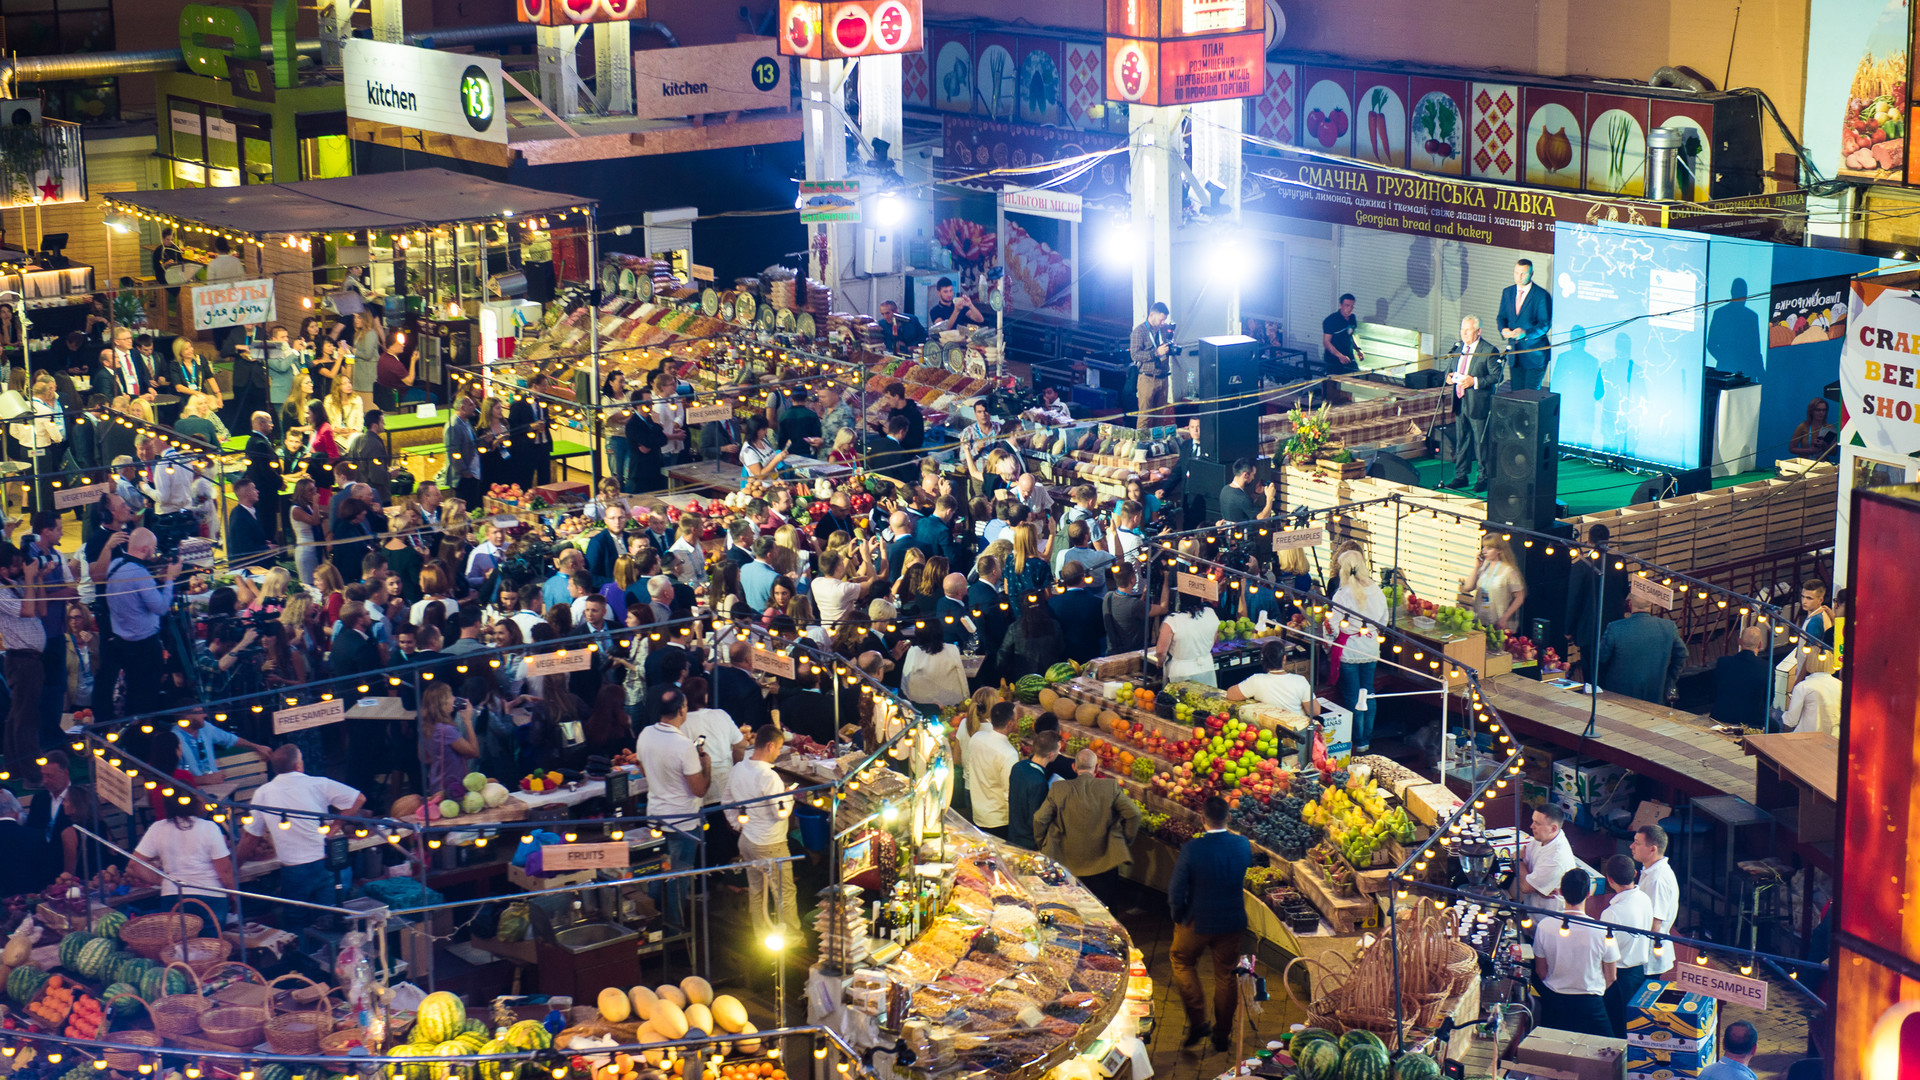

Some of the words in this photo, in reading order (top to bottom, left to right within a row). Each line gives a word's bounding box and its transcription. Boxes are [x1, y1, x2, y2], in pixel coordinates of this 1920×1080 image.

[1202, 43, 1224, 58] ПЛАН
[1189, 57, 1235, 72] РОЗМІЩЕННЯ
[662, 81, 708, 97] kitchen
[755, 63, 775, 84] 13
[1176, 70, 1226, 87] ТОРГОВЕЛЬНИХ
[1228, 68, 1249, 81] МІСЦЬ
[366, 80, 417, 112] kitchen
[462, 76, 491, 120] 13
[1174, 88, 1183, 100] ПО
[1186, 86, 1218, 99] ПРОФІЛЮ
[1220, 82, 1250, 95] ТОРГІВЛІ
[1299, 166, 1368, 192] СМАЧНА
[1376, 176, 1486, 208] ГРУЗИНСЬКА
[1493, 190, 1556, 217] ЛАВКА
[1774, 193, 1805, 208] ЛАВКА
[1004, 192, 1048, 210] ПІЛЬГОВІ
[1050, 200, 1081, 214] МІСЦЯ
[1278, 187, 1313, 199] сулугуні,
[1315, 193, 1353, 205] лимонад,
[1355, 198, 1386, 210] аджика
[1388, 200, 1392, 210] і
[1394, 202, 1429, 216] ткемалі,
[1430, 207, 1455, 219] свіже
[1456, 212, 1486, 223] лаваш
[1488, 213, 1492, 224] і
[1494, 215, 1535, 232] хачапурі
[1537, 221, 1543, 230] з
[1355, 210, 1399, 228] Georgian
[1402, 216, 1431, 231] bread
[1434, 223, 1454, 235] and
[1457, 223, 1493, 244] bakery
[199, 284, 268, 306] ЦВЕТЫ
[203, 308, 228, 325] для
[229, 305, 263, 322] дачи
[704, 408, 730, 416] SAMPLES
[1276, 535, 1292, 544] FREE
[1292, 532, 1320, 542] SAMPLES
[1188, 580, 1206, 591] FRUITS
[1633, 580, 1646, 592] FREE
[1646, 585, 1670, 602] SAMPLES
[535, 655, 584, 668] VEGETABLES
[278, 714, 300, 726] FREE
[301, 706, 341, 721] SAMPLES
[568, 850, 605, 860] FRUITS
[1681, 971, 1708, 987] FREE
[1711, 978, 1762, 999] SAMPLES
